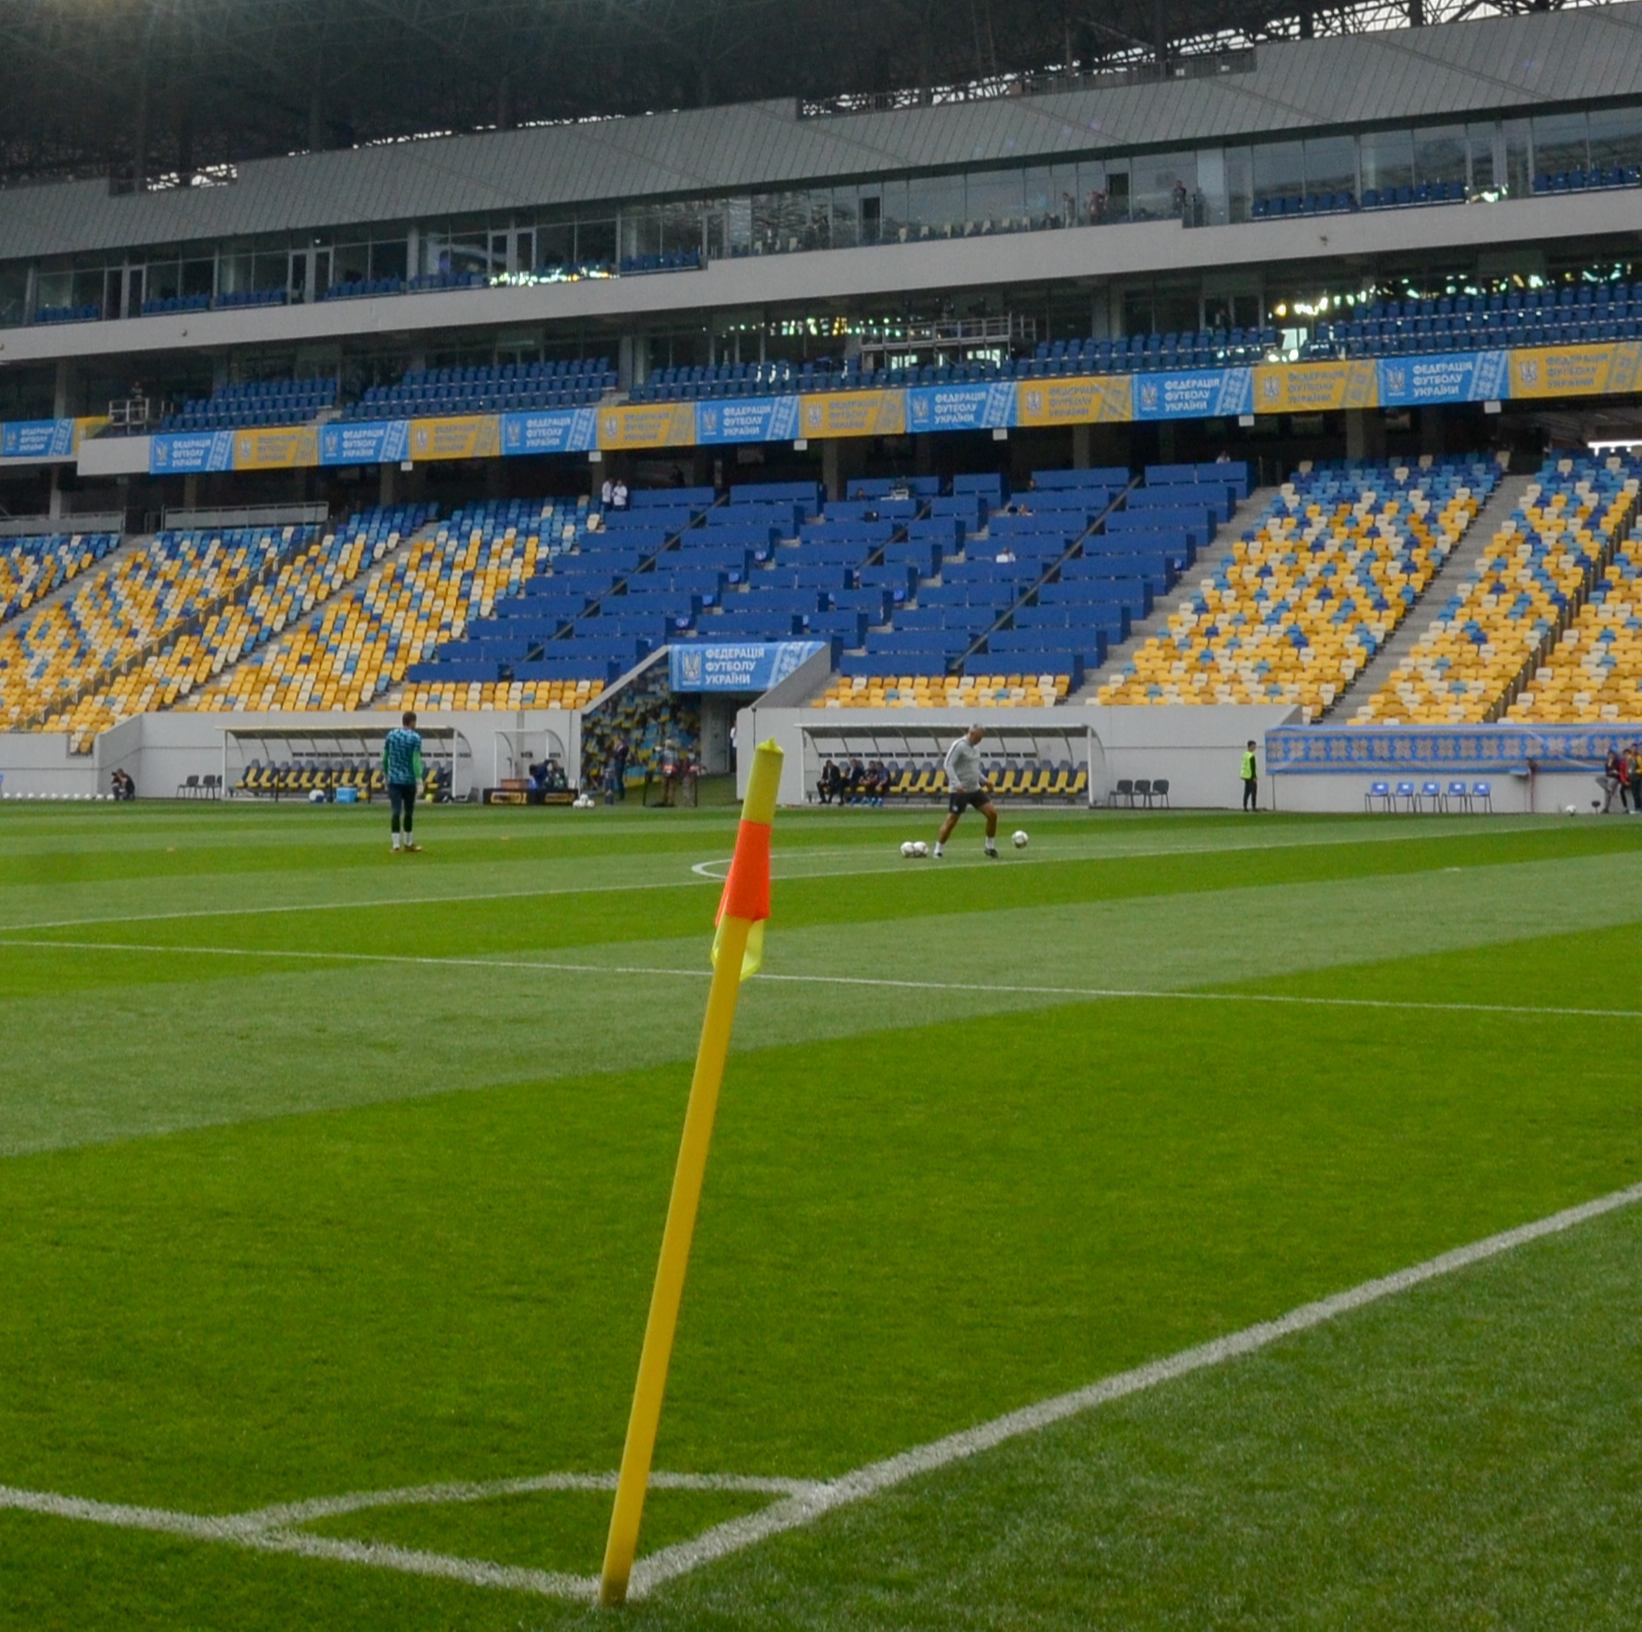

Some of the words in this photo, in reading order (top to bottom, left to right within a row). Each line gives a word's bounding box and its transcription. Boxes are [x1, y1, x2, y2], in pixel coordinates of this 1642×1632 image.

[1413, 362, 1473, 375] ФЕДЕРАЦІЯ
[1165, 379, 1220, 390] ФЕДЕРАЦІЯ
[1413, 375, 1462, 386] ФУТБОЛУ
[935, 391, 987, 403] ФЕДЕРАЦІЯ
[1165, 390, 1211, 401] ФУТБОЛУ
[1414, 385, 1459, 398] УКРАЇНИ
[723, 405, 771, 417] ФЕДЕРАЦІЯ
[935, 402, 977, 413] ФУТБОЛУ
[1165, 400, 1207, 412] УКРАЇНИ
[526, 417, 571, 429] ФЕДЕРАЦІЯ
[723, 416, 763, 427] ФУТБОЛУ
[934, 413, 974, 424] УКРАЇНИ
[526, 428, 564, 438] ФУТБОЛУ
[723, 426, 760, 437] УКРАЇНИ
[526, 438, 560, 448] УКРАЇНИ
[705, 648, 765, 659] ФЕДЕРАЦІЯ
[705, 661, 756, 672] ФУТБОЛУ
[705, 672, 750, 685] УКРАЇНИ
